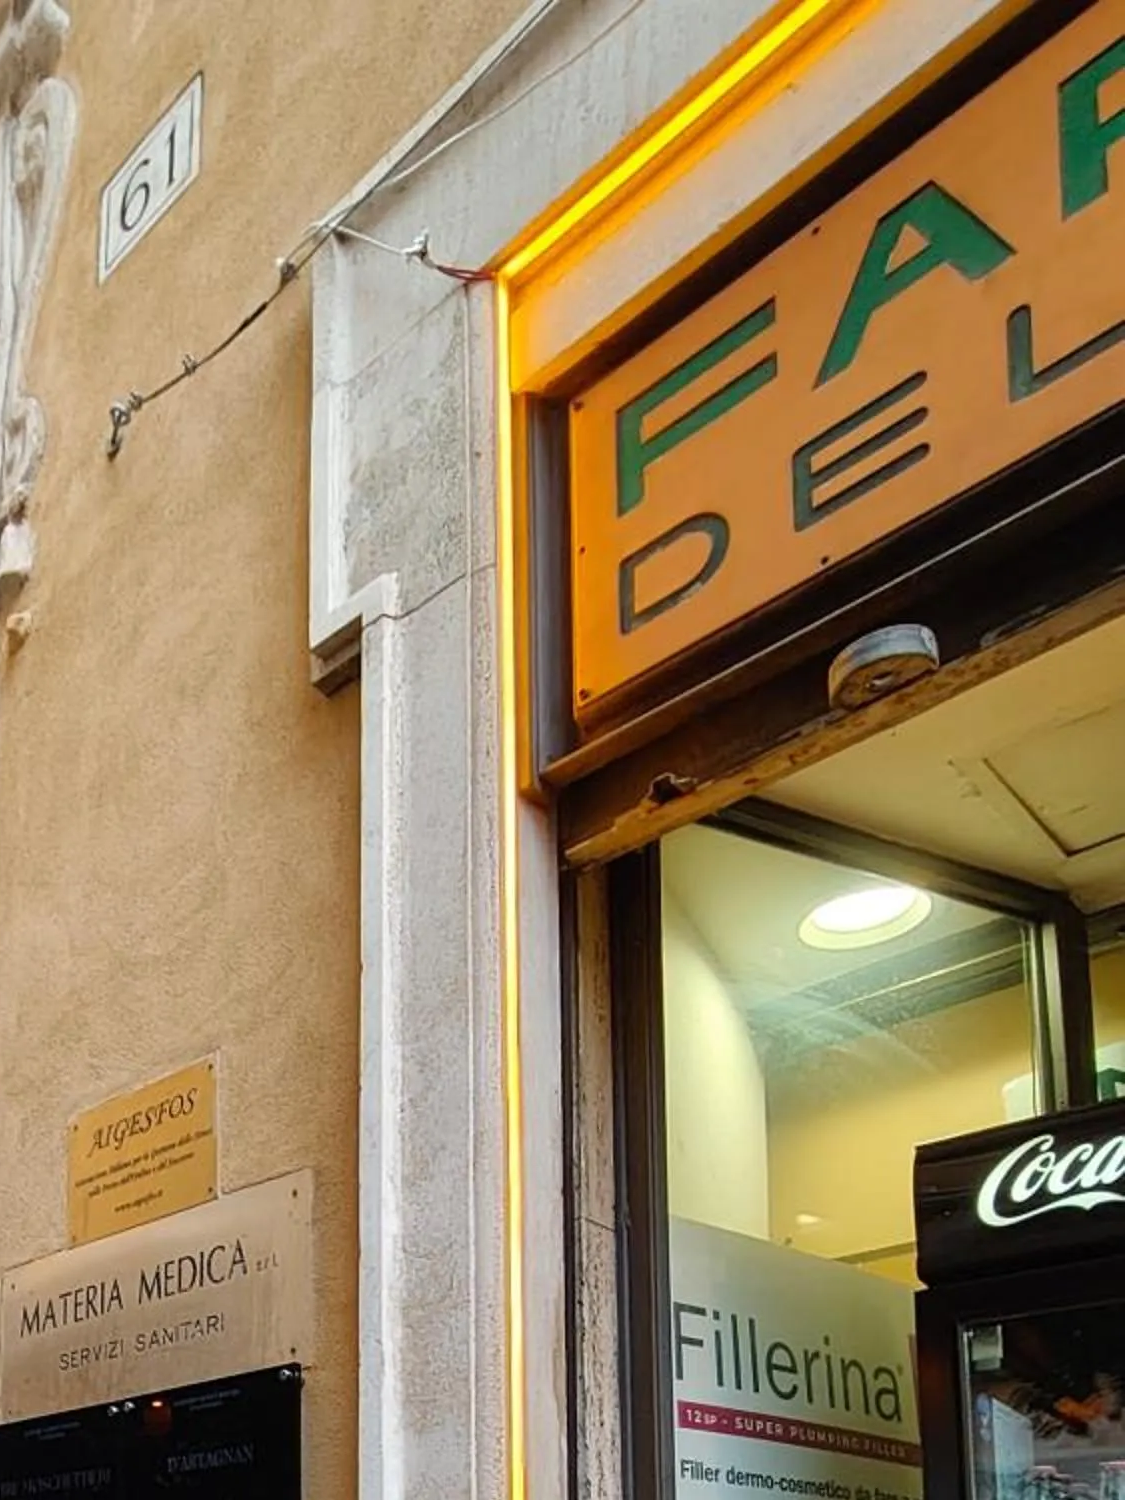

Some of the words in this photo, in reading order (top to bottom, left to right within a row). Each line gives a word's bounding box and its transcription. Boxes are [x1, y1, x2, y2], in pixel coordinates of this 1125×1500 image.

[120, 121, 176, 232] 61
[87, 1087, 198, 1158] AIGESFOS
[20, 1278, 124, 1338] MATERIA
[138, 1238, 248, 1304] MEDICA
[59, 1339, 124, 1371] SERVIZI
[135, 1312, 224, 1351] SANITARI
[674, 1301, 902, 1423] Fillerina
[735, 1416, 784, 1437] SUPER
[790, 1425, 860, 1449] PLUMPING
[680, 1459, 720, 1482] Filler
[726, 1465, 851, 1500] dermo-cosmetico
